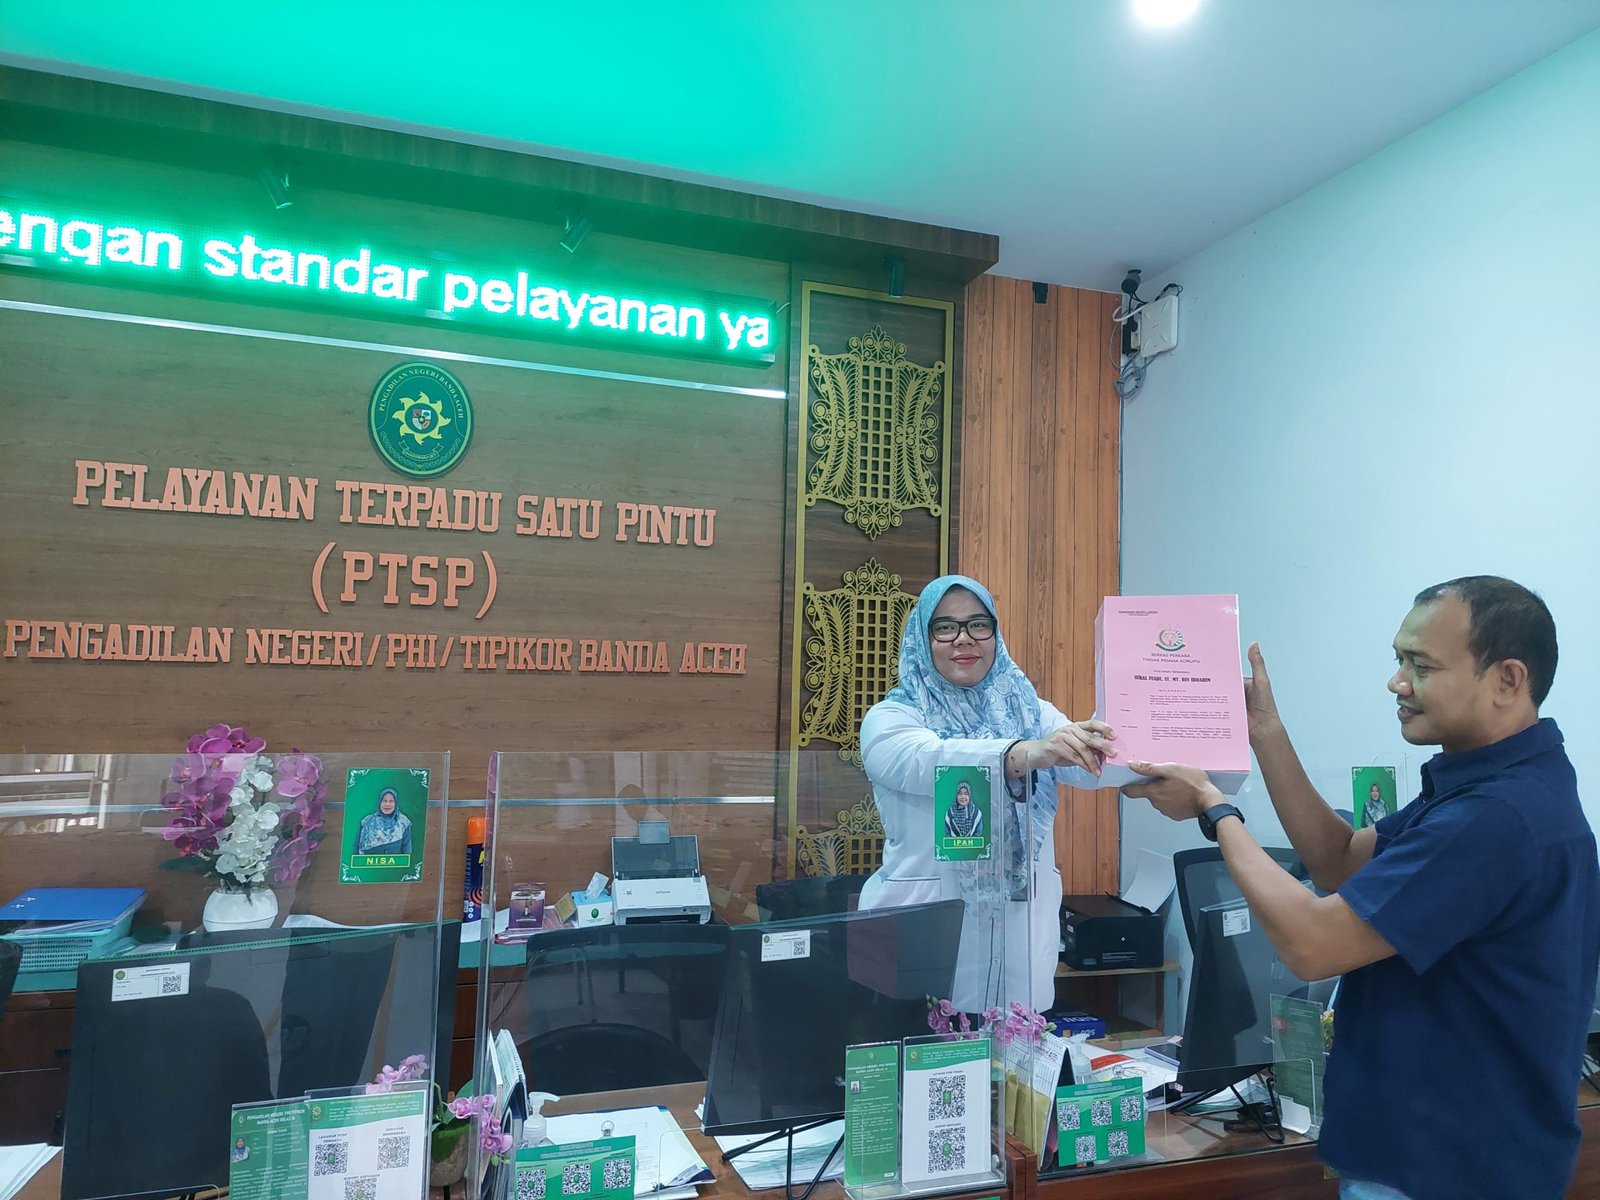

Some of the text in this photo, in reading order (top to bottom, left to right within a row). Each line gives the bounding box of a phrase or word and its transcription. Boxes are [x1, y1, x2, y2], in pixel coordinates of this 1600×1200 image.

[203, 234, 429, 302] standar
[443, 271, 706, 341] pelayanan
[719, 311, 770, 350] ya
[379, 368, 464, 418] PENGADILAN NEGERI BANDA ACEH
[73, 460, 716, 547] PELAYANAN TERPADU SATU PINTU
[311, 541, 498, 620] (PTSP)
[5, 619, 234, 663] PENGADILAN
[578, 639, 671, 673] BANDA
[679, 642, 747, 675] ACEH
[366, 855, 396, 866] NISA
[953, 839, 973, 847] IPAH
